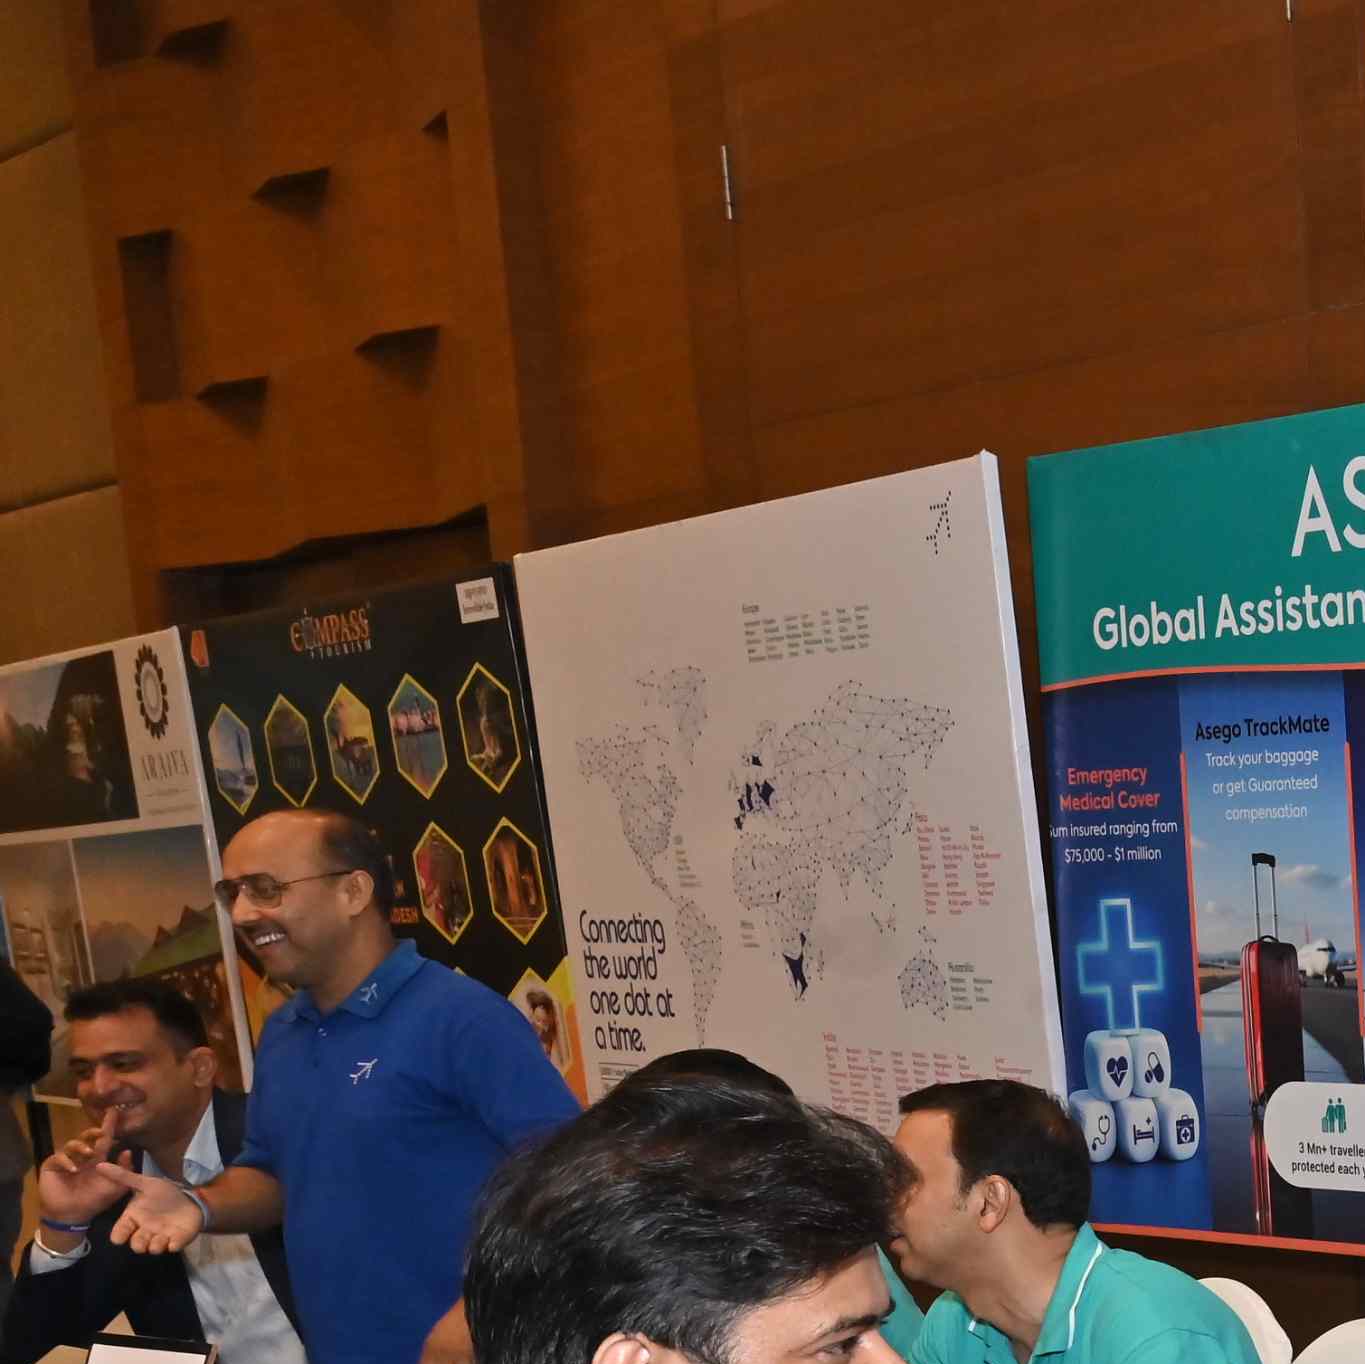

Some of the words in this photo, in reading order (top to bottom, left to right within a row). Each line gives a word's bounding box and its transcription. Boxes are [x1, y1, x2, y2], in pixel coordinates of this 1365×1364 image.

[1093, 596, 1205, 650] Global
[1195, 721, 1241, 742] Asego
[1245, 715, 1330, 738] TrackMate
[1206, 752, 1235, 767] Track
[1238, 753, 1262, 767] your
[1265, 749, 1319, 766] baggage
[1067, 768, 1147, 788] Emergency
[1213, 781, 1223, 793] or
[1226, 780, 1246, 795] get
[1248, 776, 1318, 792] Guaranteed
[1060, 792, 1114, 810] Medical
[1119, 790, 1160, 808] Cover
[1225, 806, 1307, 822] compensation
[1071, 822, 1106, 836] insured
[1109, 821, 1149, 838] ranging
[1152, 819, 1177, 832] from
[1064, 847, 1104, 863] $75,000
[1115, 846, 1125, 862] $1
[1127, 845, 1161, 860] million
[580, 910, 665, 954] Connecting
[584, 947, 610, 978] the
[613, 947, 657, 980] world
[590, 991, 620, 1015] one
[624, 982, 652, 1016] dot
[656, 989, 675, 1017] at
[595, 1026, 606, 1049] a
[608, 1021, 646, 1051] time.
[1299, 1142, 1305, 1155] 3
[1308, 1143, 1327, 1156] Mn+
[1291, 1159, 1335, 1175] protected
[1338, 1161, 1360, 1175] each
